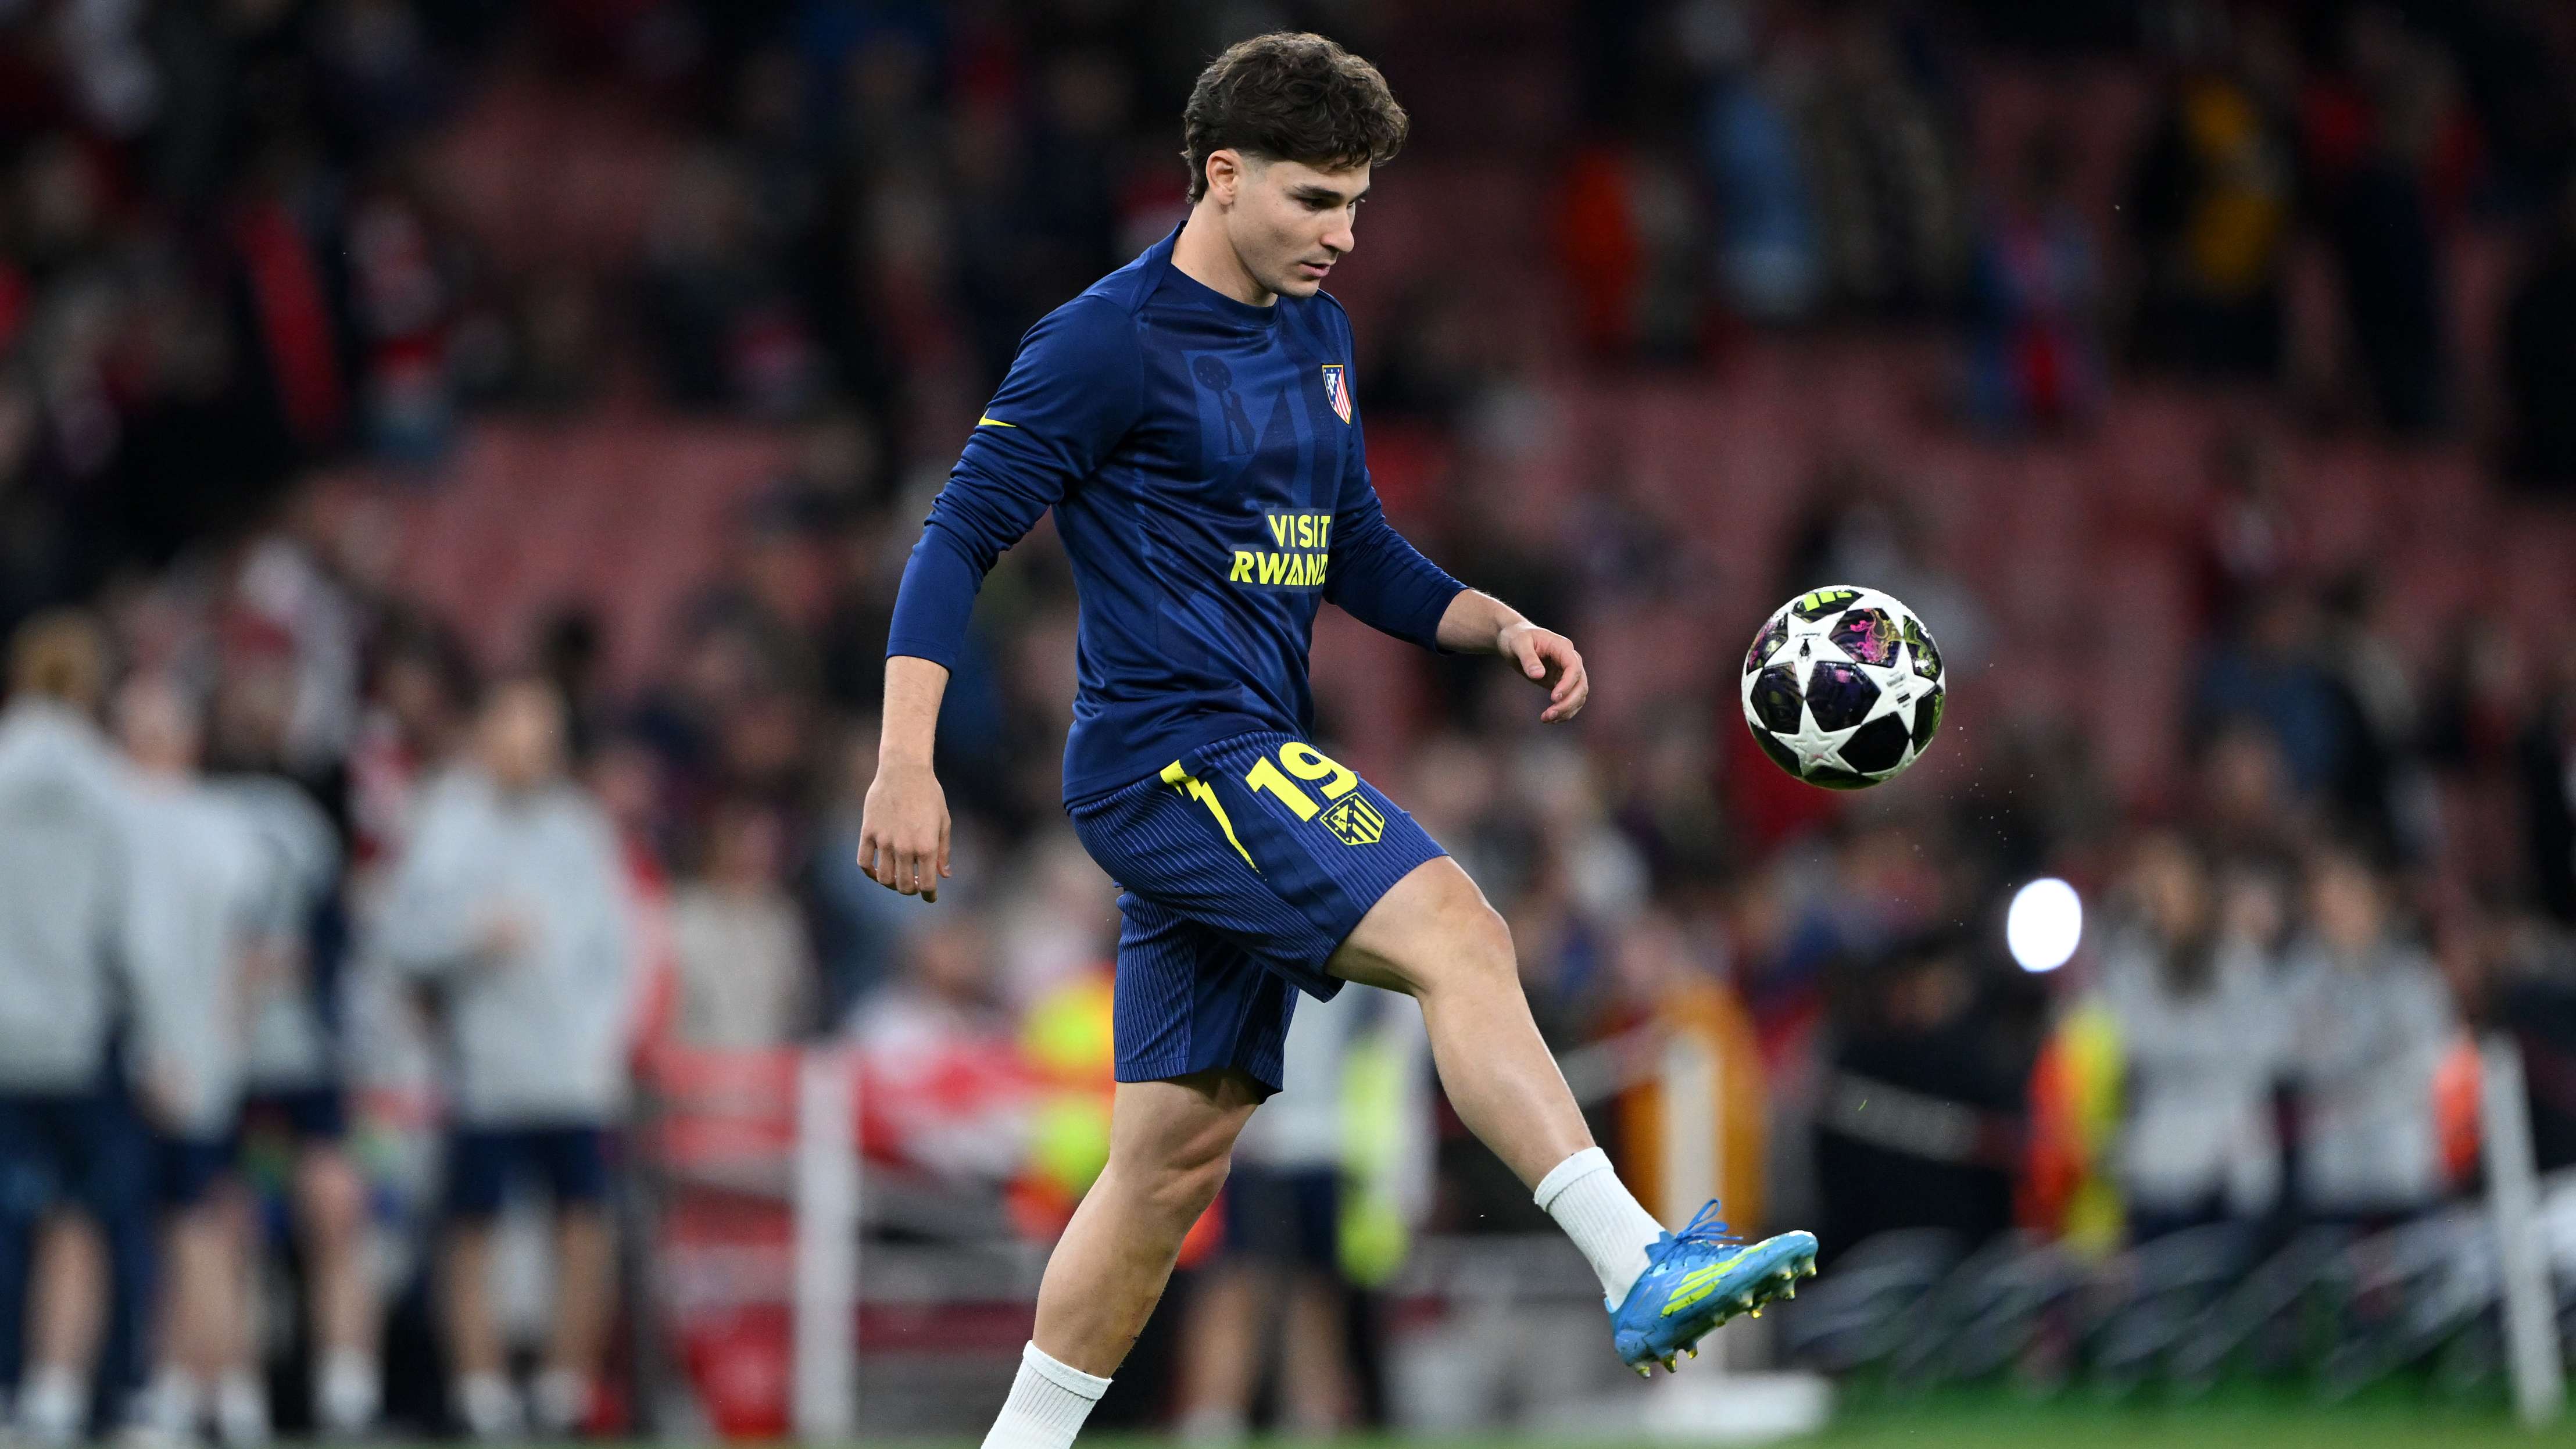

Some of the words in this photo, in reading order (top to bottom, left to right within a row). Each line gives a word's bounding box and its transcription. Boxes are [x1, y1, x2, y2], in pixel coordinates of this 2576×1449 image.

[1268, 514, 1331, 548] VISIT
[1229, 550, 1328, 586] RWAND
[1246, 742, 1358, 822] 19
